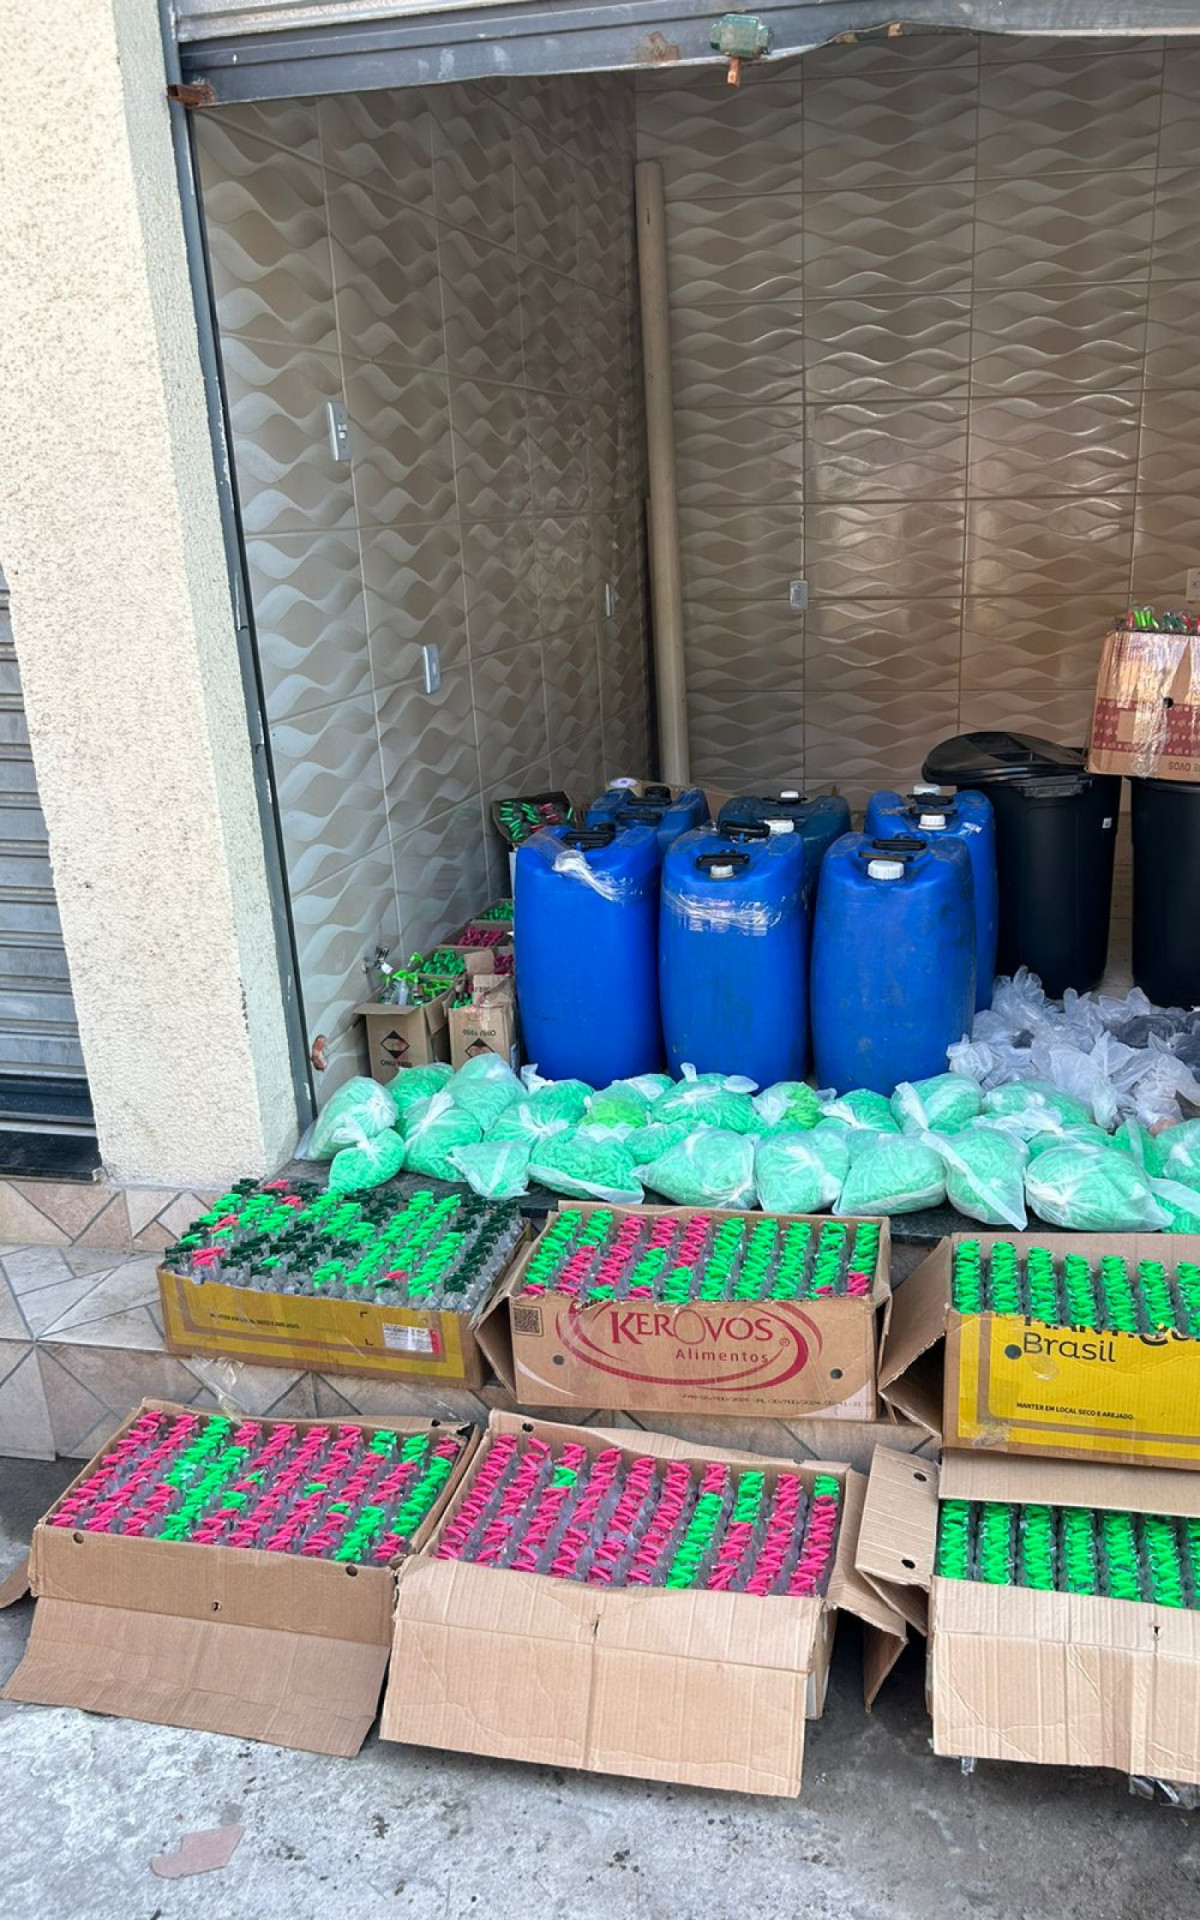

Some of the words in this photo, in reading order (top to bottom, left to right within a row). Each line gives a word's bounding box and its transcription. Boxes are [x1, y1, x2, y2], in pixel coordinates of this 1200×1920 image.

[609, 1309, 774, 1345] KEROVOS
[675, 1349, 769, 1363] Alimentos
[1023, 1332, 1116, 1363] Brasil
[1016, 1402, 1044, 1411] MANTER
[1056, 1406, 1077, 1415] LOCAL
[1078, 1409, 1096, 1417] SECO
